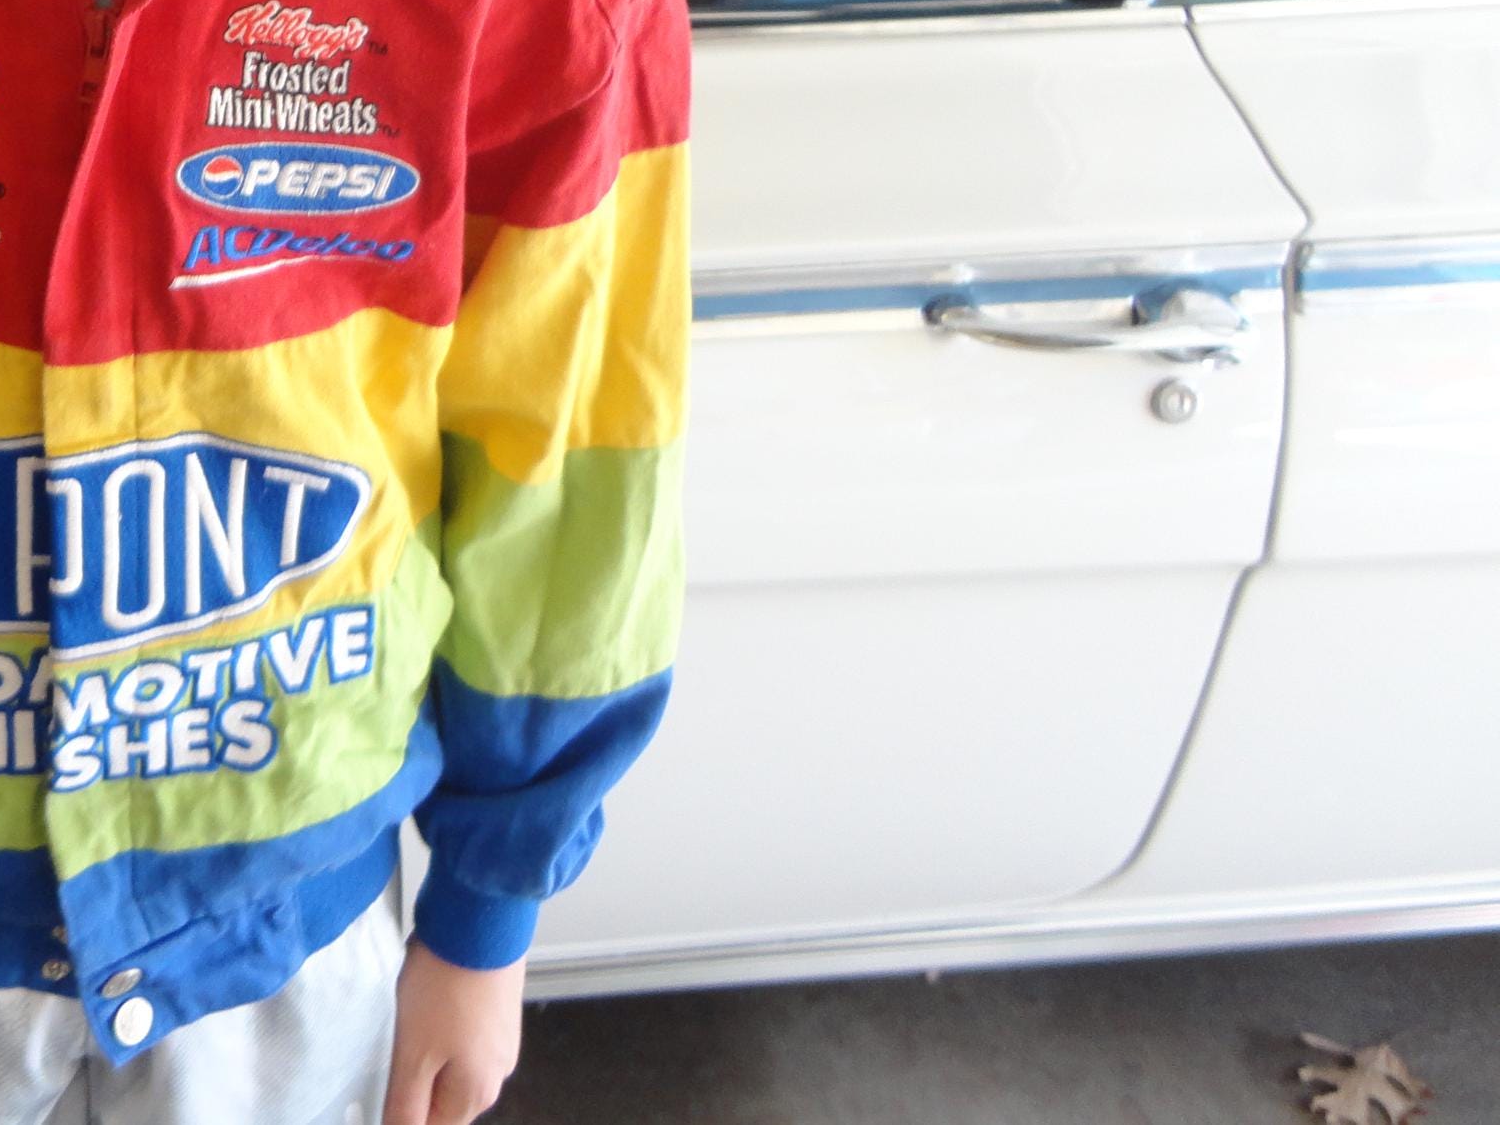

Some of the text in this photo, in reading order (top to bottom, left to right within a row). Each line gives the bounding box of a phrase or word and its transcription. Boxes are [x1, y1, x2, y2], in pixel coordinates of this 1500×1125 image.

[223, 0, 369, 59] Kellogg's
[242, 51, 351, 94] Frosted
[240, 159, 396, 200] PEPSI
[183, 225, 415, 271] ACDelco
[16, 452, 329, 630] PONT
